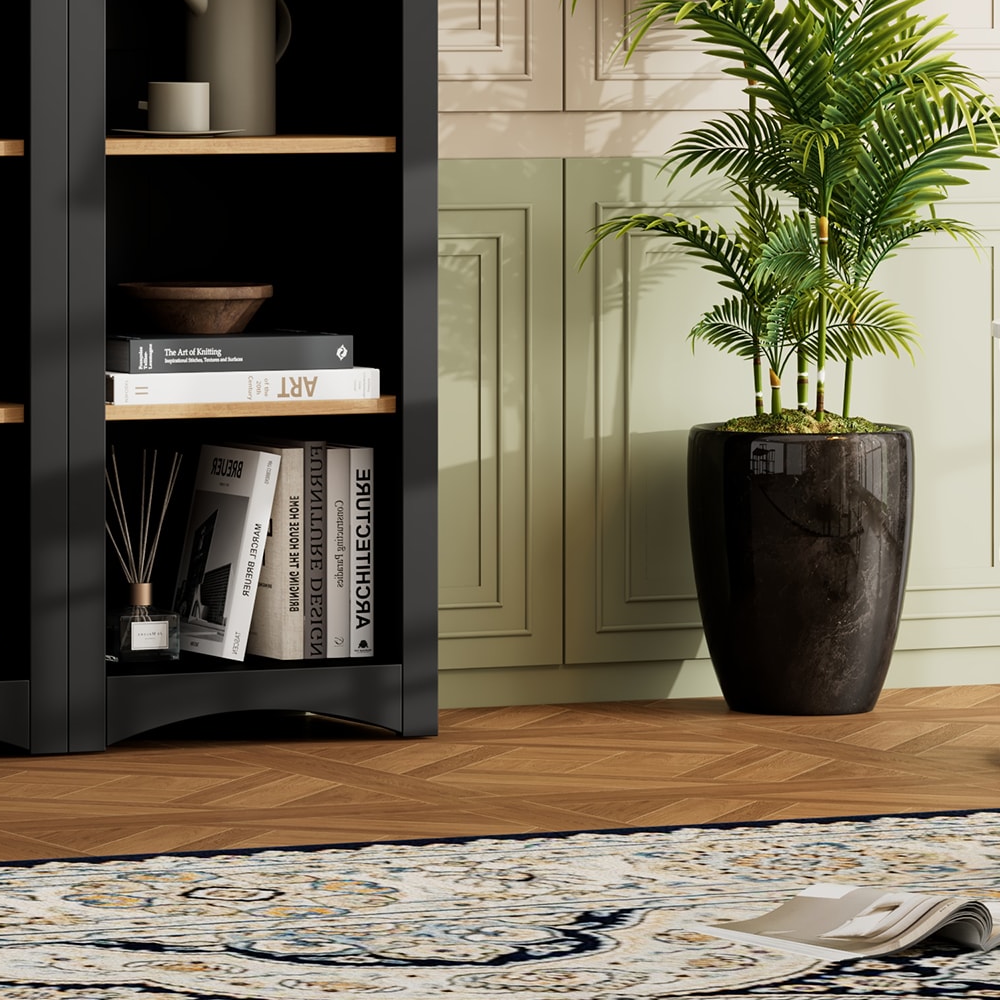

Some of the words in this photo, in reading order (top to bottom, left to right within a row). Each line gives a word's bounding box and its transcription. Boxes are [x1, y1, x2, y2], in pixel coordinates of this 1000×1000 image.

[164, 348, 177, 357] The
[177, 348, 189, 356] Art
[189, 347, 197, 356] of
[196, 347, 222, 358] Knitting
[277, 376, 318, 398] ART
